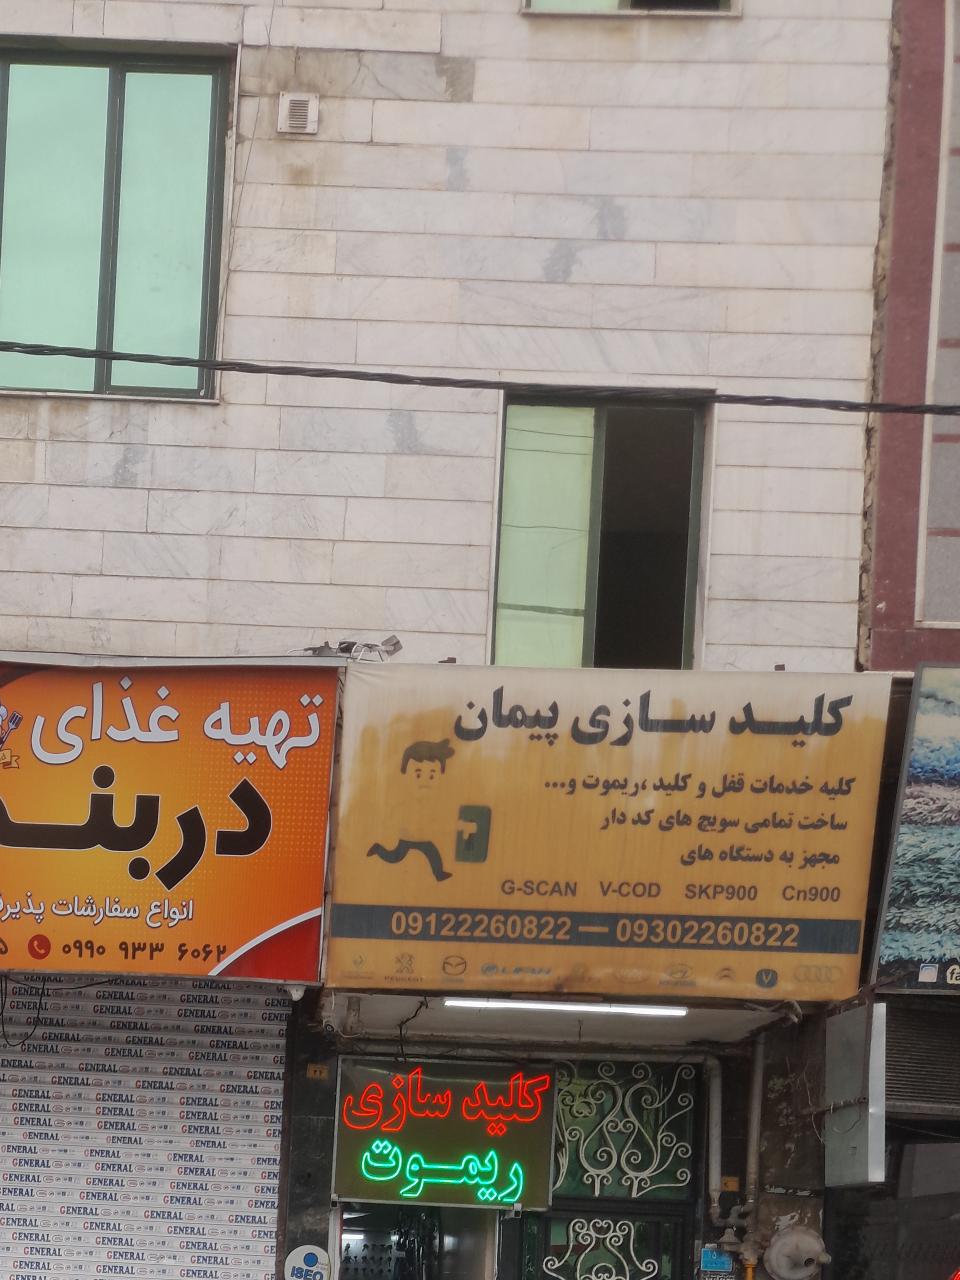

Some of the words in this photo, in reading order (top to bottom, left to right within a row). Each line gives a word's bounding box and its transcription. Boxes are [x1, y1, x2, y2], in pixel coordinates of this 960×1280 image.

[31, 676, 180, 765] غذای
[454, 685, 559, 745] پیمان
[571, 690, 716, 747] سازی
[729, 692, 853, 747] کلید
[203, 693, 324, 769] تهیه
[653, 772, 691, 796] کلید
[696, 782, 706, 799] و
[712, 772, 744, 798] قفل
[750, 775, 813, 796] خدمات
[819, 777, 856, 801] کلیه
[600, 808, 626, 830] دار
[631, 808, 654, 827] کد
[658, 810, 691, 831] های
[744, 811, 793, 833] تمامی
[798, 811, 847, 831] ساخت
[680, 845, 713, 866] های
[719, 846, 773, 863] دستگاه
[779, 853, 794, 868] به
[798, 852, 840, 869] مجهز
[501, 880, 577, 897] G-SCAN
[599, 881, 662, 898] V-COD
[685, 883, 758, 901] SKP900
[782, 885, 840, 902] Cn900
[51, 895, 139, 924] سفارشات
[146, 897, 194, 928] انواع
[390, 911, 571, 940] 09122260822
[616, 919, 800, 947] 09302260822
[62, 940, 106, 960] ۰۹۹۰
[119, 941, 164, 961] ۹۳۳
[93, 1004, 132, 1015] GENERAL
[78, 1062, 117, 1073] GENERAL
[51, 1075, 90, 1086] GENERAL
[95, 1092, 134, 1103] GENERAL
[342, 1065, 452, 1132] سازی
[462, 1071, 551, 1136] کلید
[13, 1116, 52, 1127] GENERAL
[97, 1120, 136, 1131] GENERAL
[179, 1110, 218, 1121] GENERAL
[94, 1162, 133, 1173] GENERAL
[177, 1166, 216, 1177] GENERAL
[361, 1138, 524, 1200] ریموت
[60, 1205, 99, 1216] GENERAL
[167, 1225, 206, 1236] GENERAL
[23, 1246, 62, 1257] GENERAL
[95, 1236, 134, 1247] GENERAL
[179, 1240, 218, 1251] GENERAL
[96, 1264, 135, 1275] GENERAL
